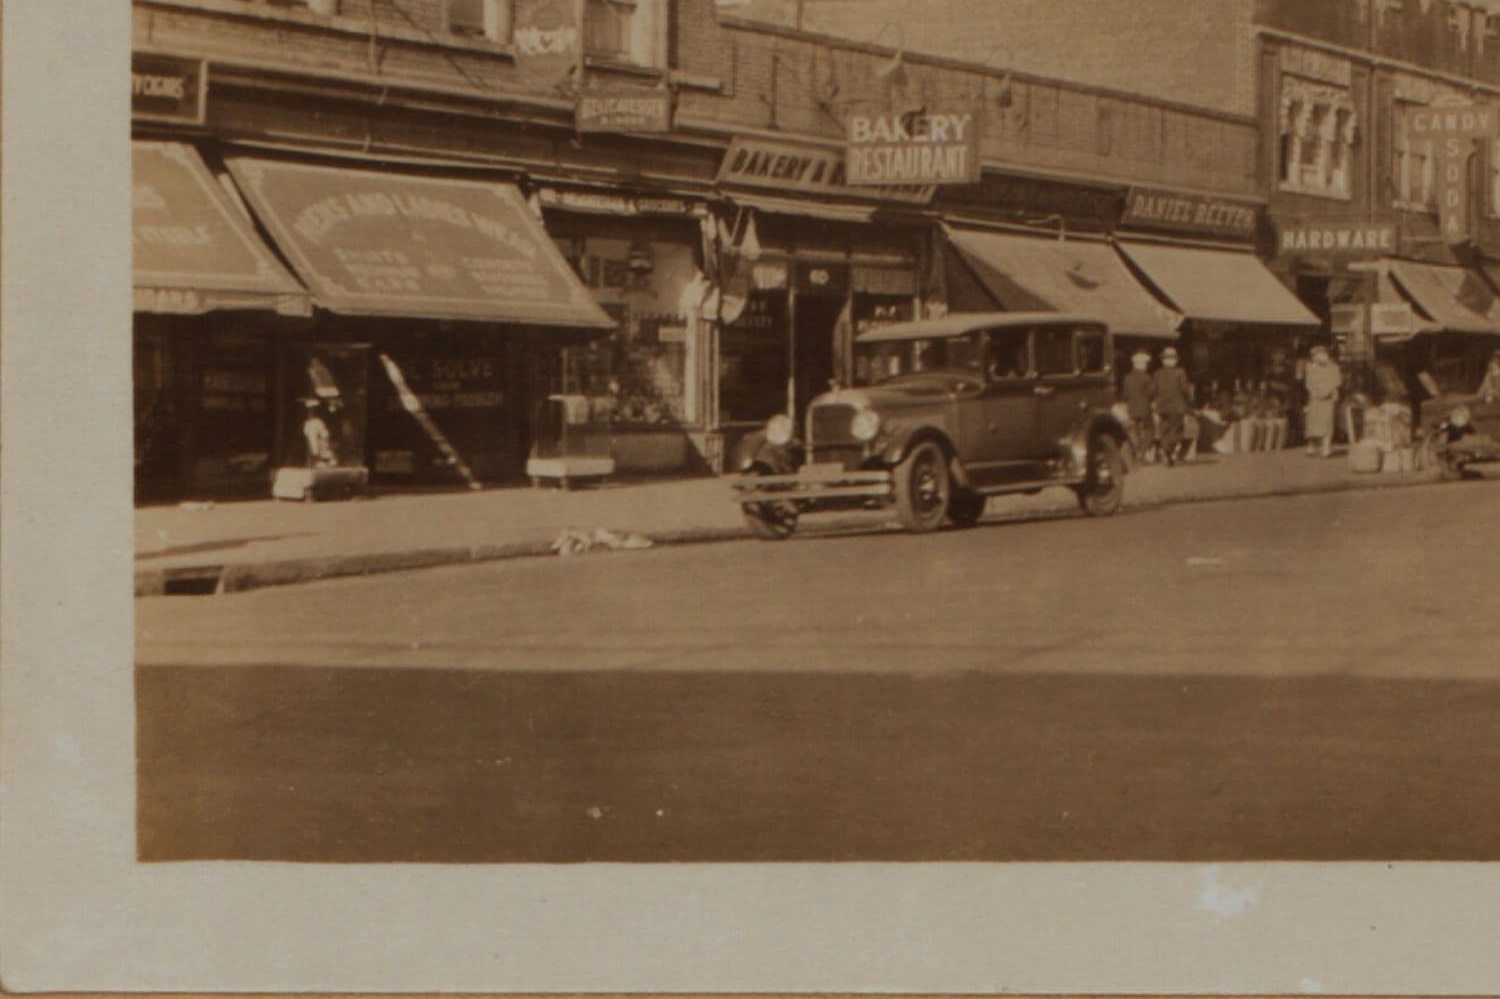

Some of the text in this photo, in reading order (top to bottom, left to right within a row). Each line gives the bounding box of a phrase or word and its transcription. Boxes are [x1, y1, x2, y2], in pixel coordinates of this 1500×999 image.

[851, 112, 972, 143] BAKERY
[1413, 112, 1489, 133] CANDY
[730, 147, 815, 182] BAKERY
[851, 143, 969, 181] RESTAURANT
[1446, 137, 1460, 234] SODA
[1131, 193, 1191, 222] DANIEL
[1193, 202, 1256, 230] REEVES
[1282, 229, 1391, 251] HARDWARE
